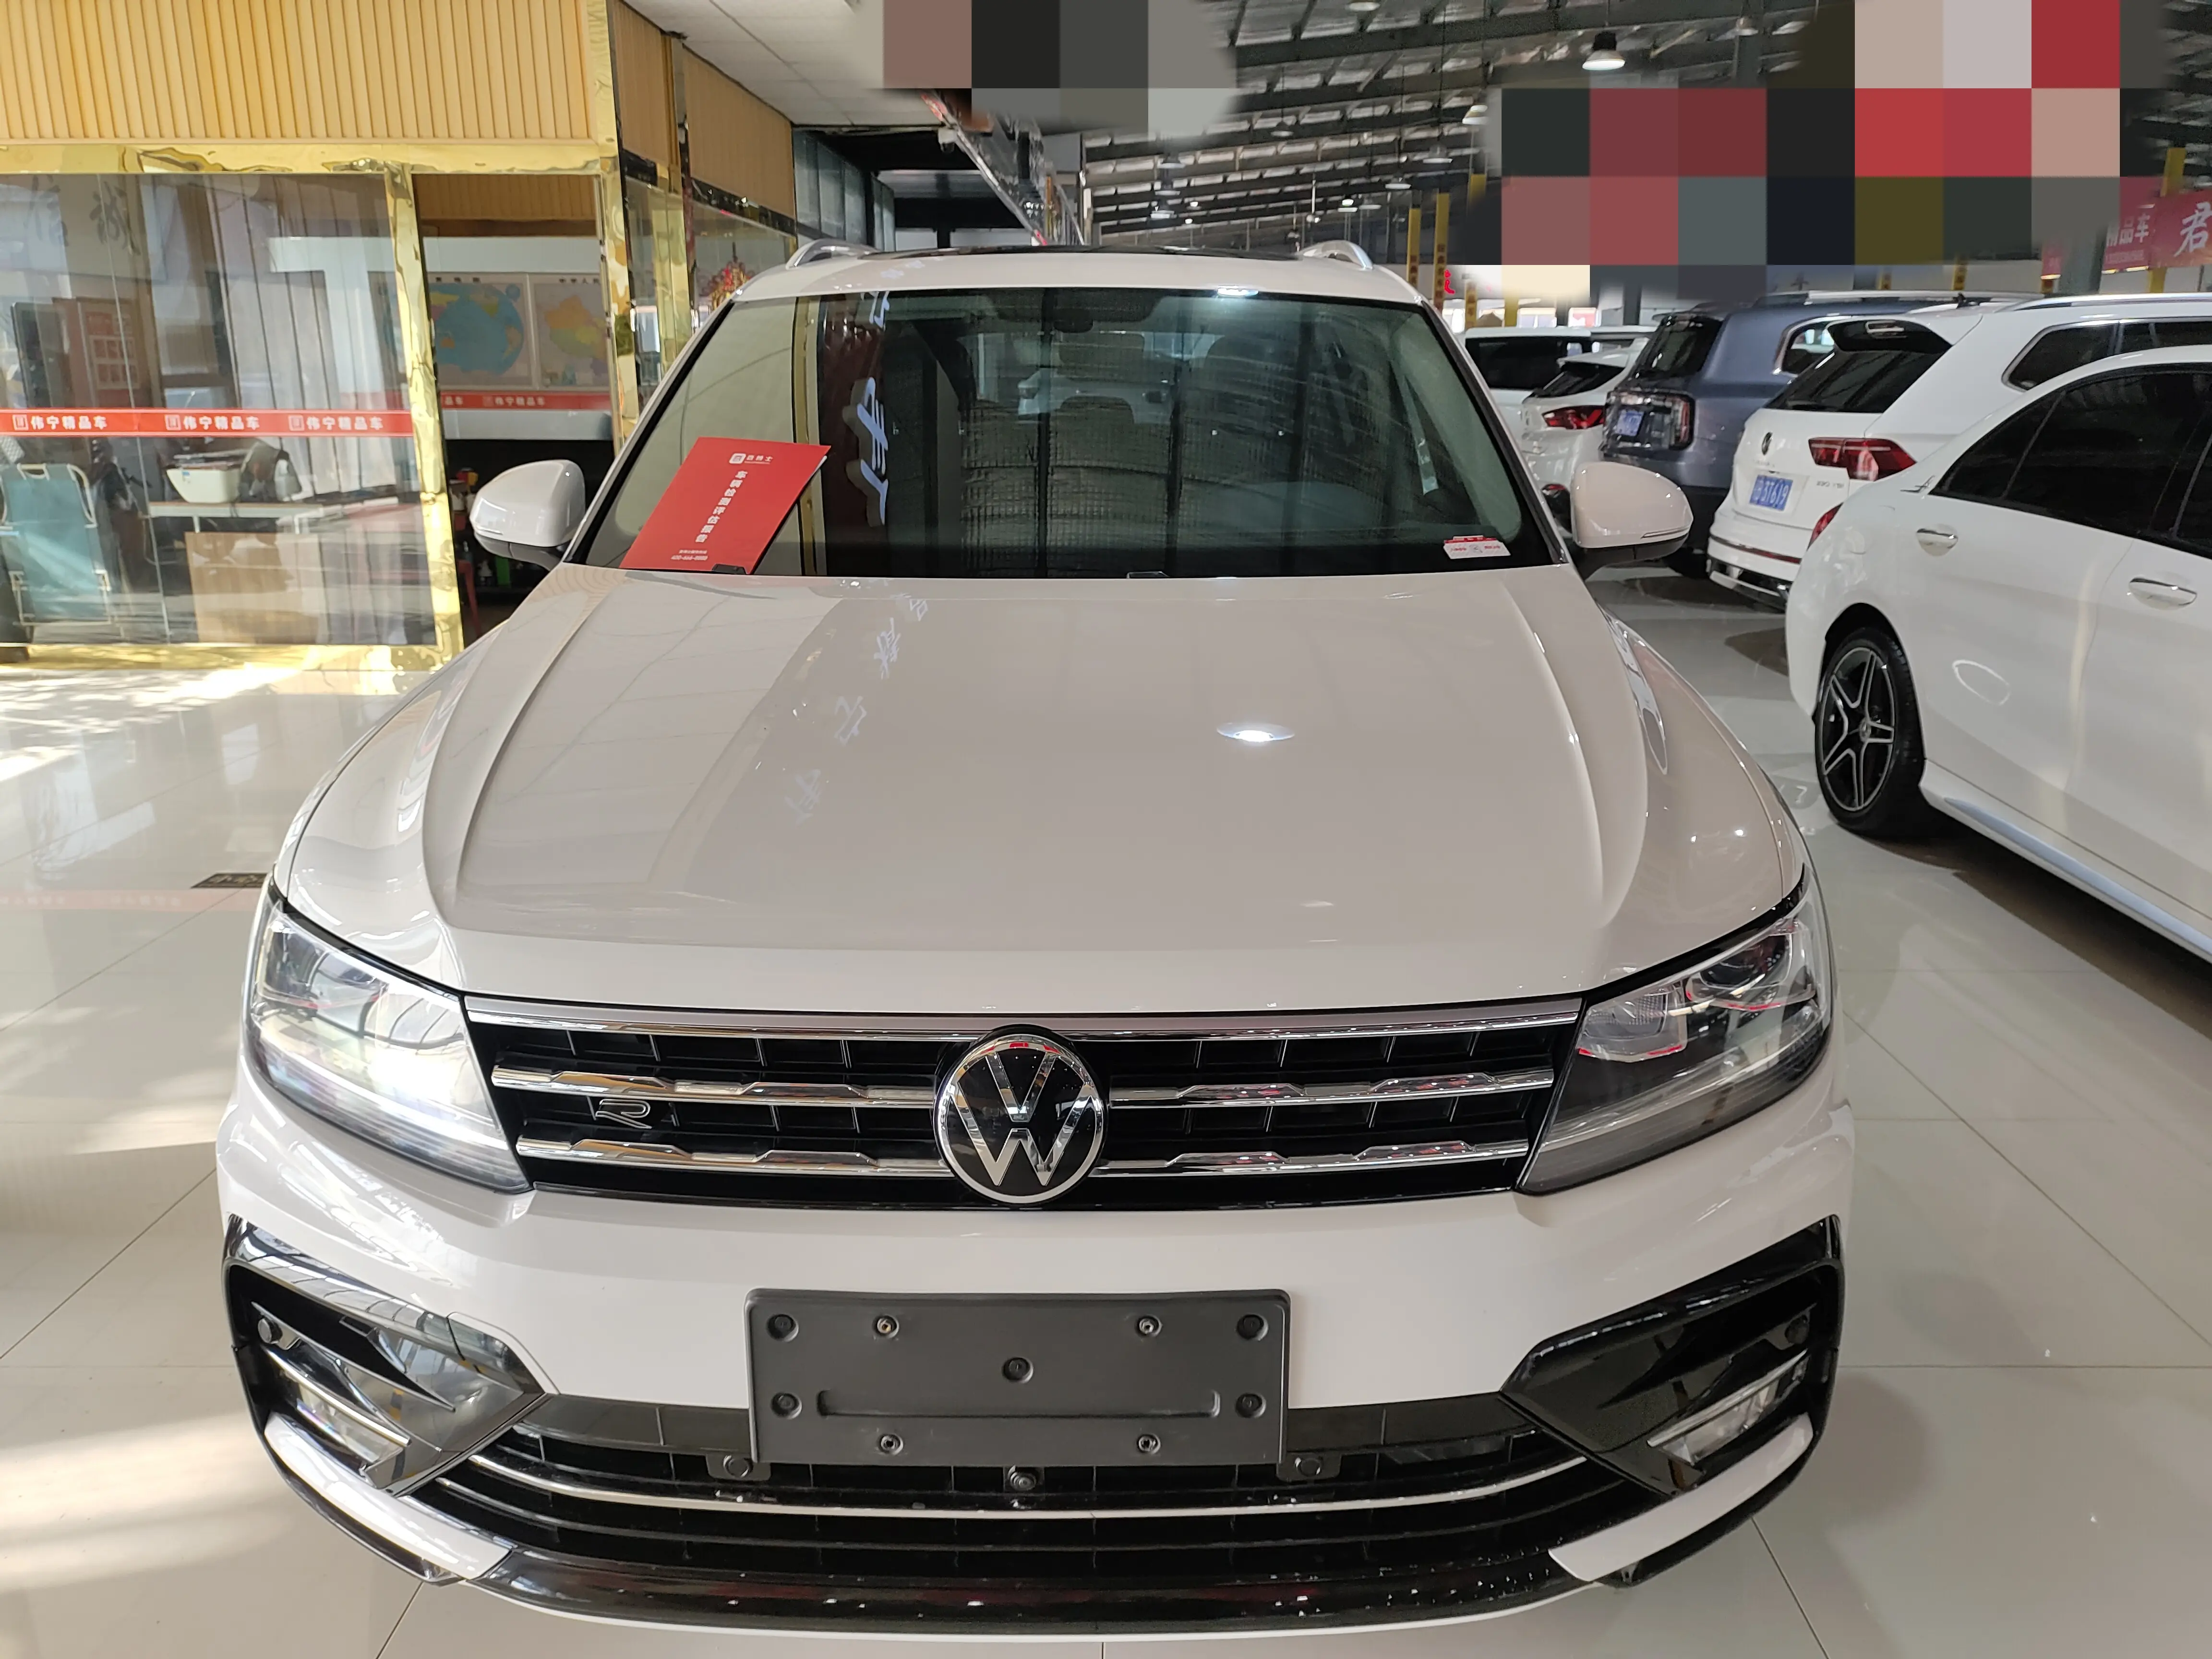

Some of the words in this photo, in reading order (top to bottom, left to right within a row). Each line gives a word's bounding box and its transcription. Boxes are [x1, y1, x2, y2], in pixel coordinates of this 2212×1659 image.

[30, 415, 107, 430] 伟宁精品车
[183, 415, 260, 430] 伟宁精品车
[306, 415, 383, 430] 伟宁精品车
